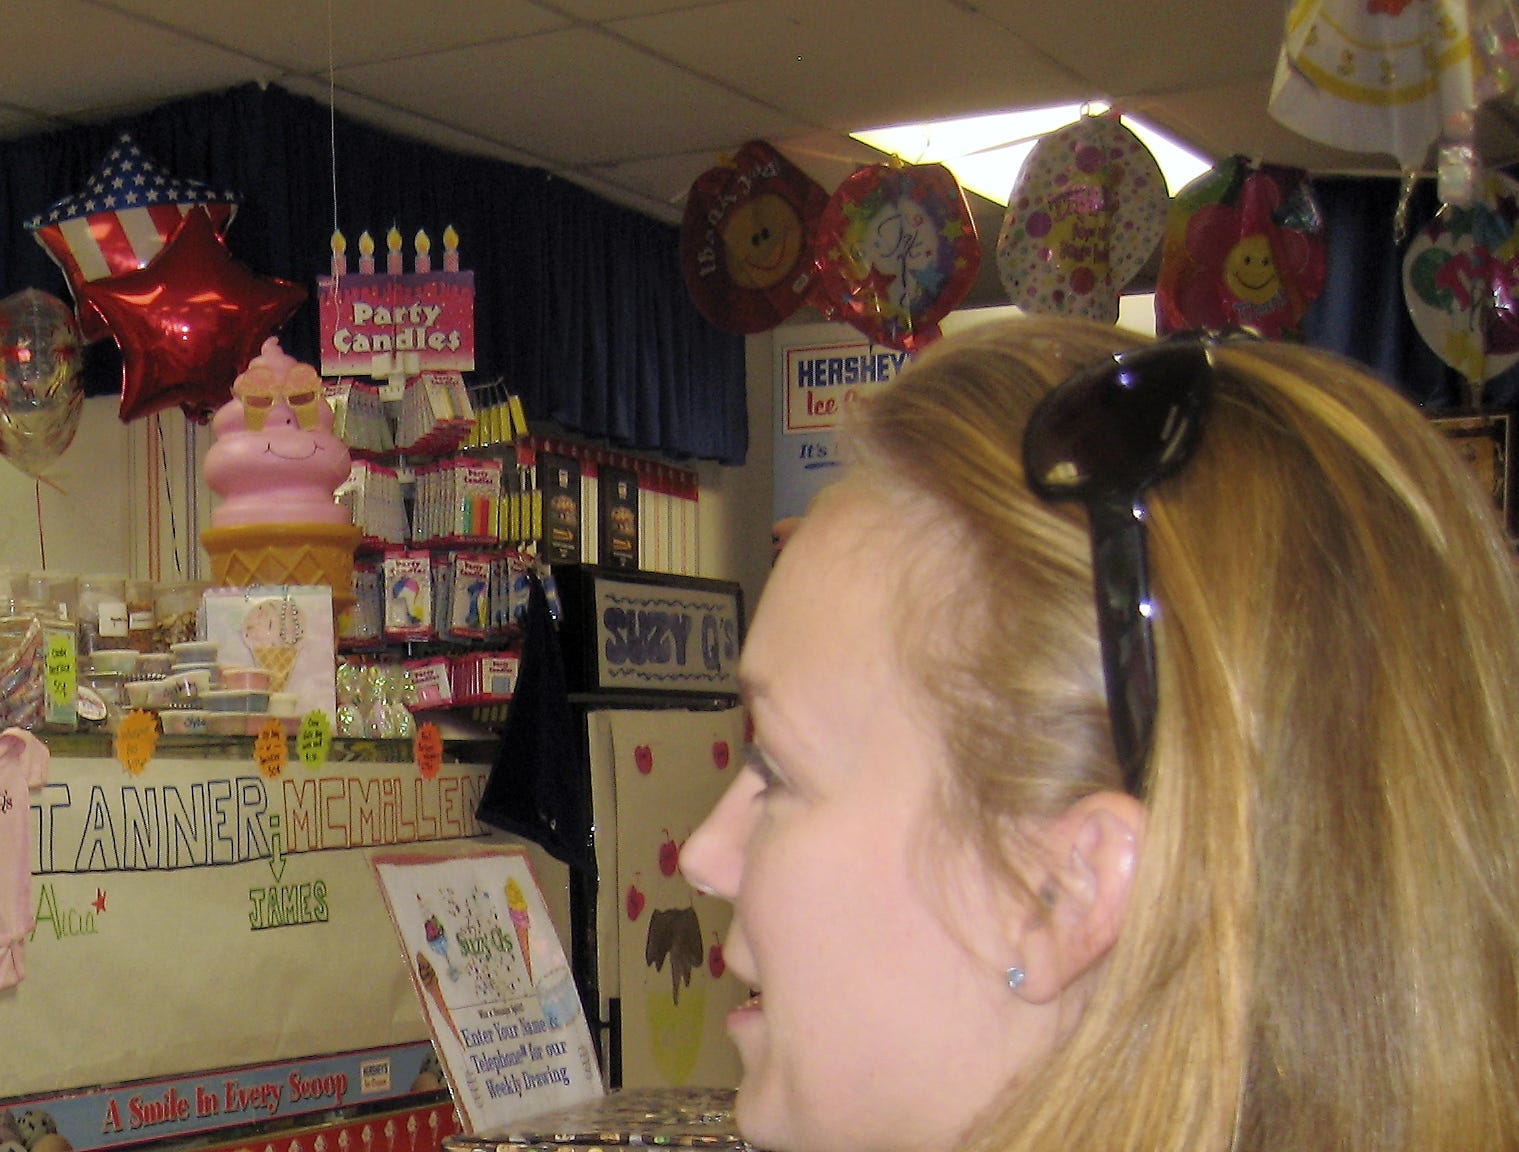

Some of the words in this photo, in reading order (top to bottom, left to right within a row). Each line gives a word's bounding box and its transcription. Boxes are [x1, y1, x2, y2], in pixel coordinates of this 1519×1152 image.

[353, 301, 442, 327] Party
[333, 328, 462, 354] Candles
[807, 391, 838, 416] Ice
[800, 444, 827, 458] It's
[603, 607, 692, 667] SUZY
[29, 776, 270, 873] TANNER
[249, 880, 328, 928] JAMES
[461, 1028, 495, 1048] Enter
[493, 1022, 518, 1041] Your
[520, 1017, 545, 1035] Name
[545, 1041, 567, 1058] our
[485, 1074, 522, 1099] Weekly
[523, 1066, 570, 1090] Drawing
[103, 1096, 123, 1133] A
[129, 1087, 189, 1129] Smile
[196, 1084, 219, 1117] In
[224, 1079, 282, 1114] Every
[288, 1070, 347, 1106] Scoop
